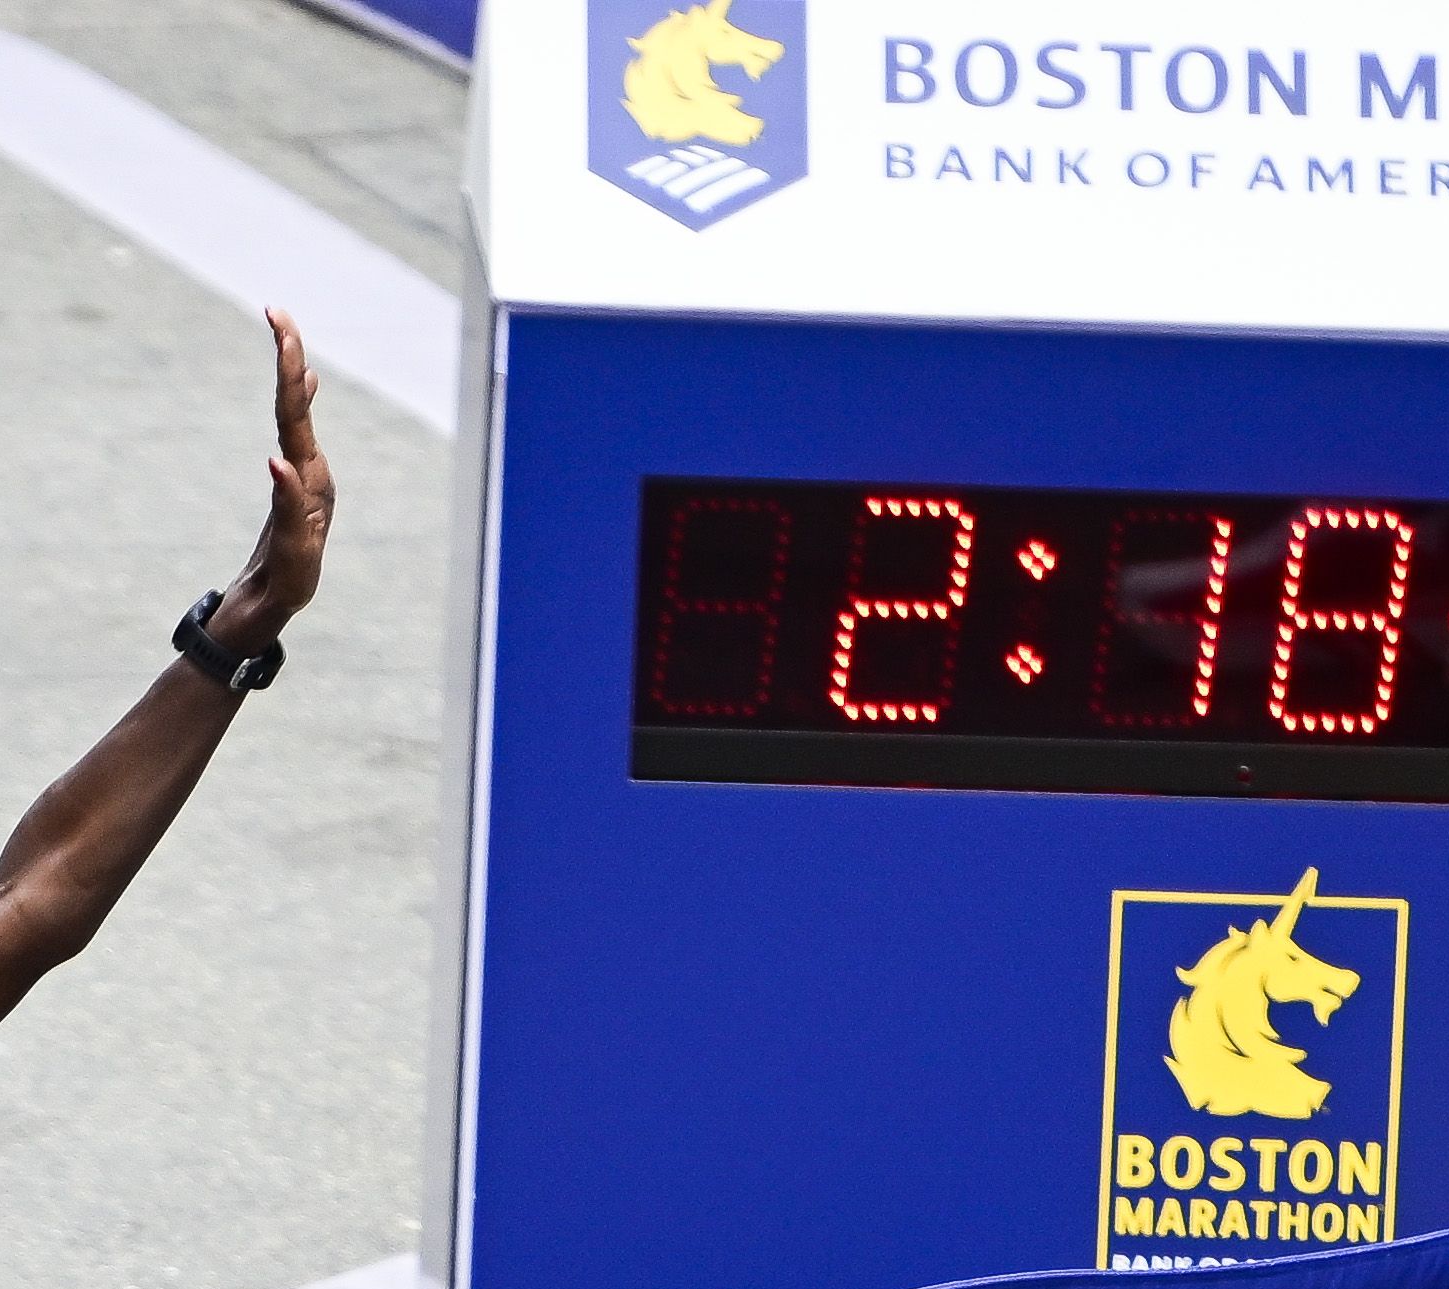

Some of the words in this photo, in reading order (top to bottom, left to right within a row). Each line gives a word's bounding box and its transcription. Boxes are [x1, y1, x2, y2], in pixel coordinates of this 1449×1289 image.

[883, 38, 1308, 117] BOSTON
[884, 144, 1091, 185] BANK
[1126, 151, 1216, 189] OF
[1116, 1134, 1382, 1196] BOSTON
[1114, 1196, 1379, 1243] MARATHON
